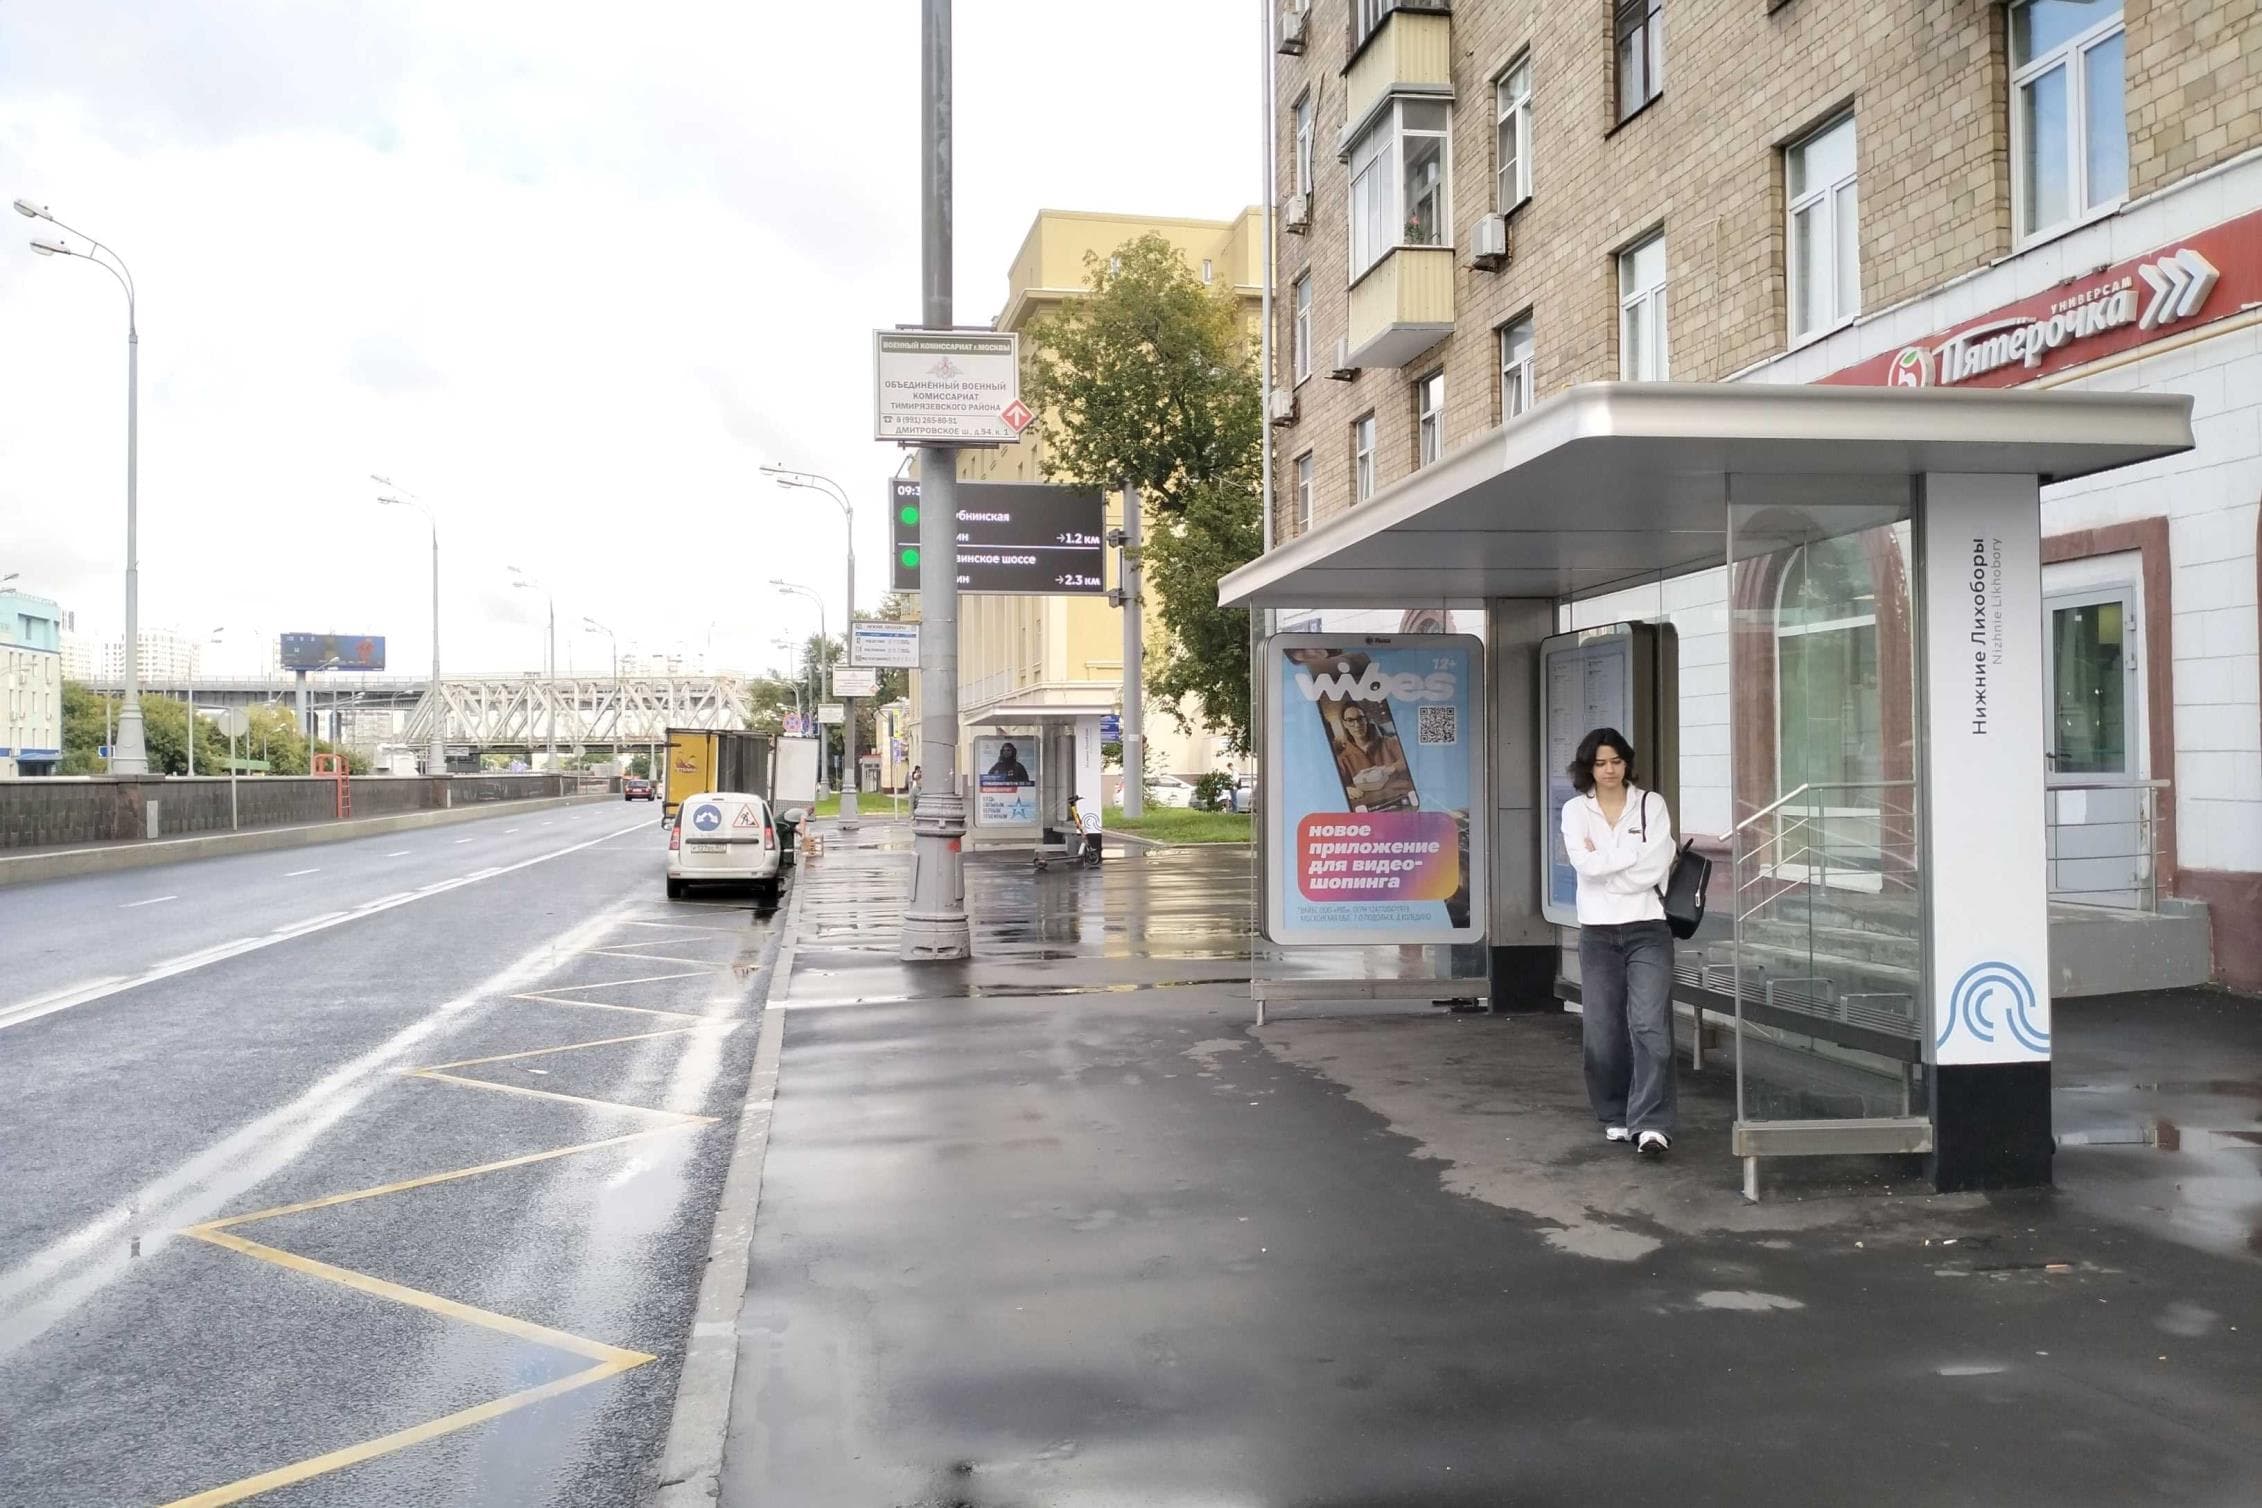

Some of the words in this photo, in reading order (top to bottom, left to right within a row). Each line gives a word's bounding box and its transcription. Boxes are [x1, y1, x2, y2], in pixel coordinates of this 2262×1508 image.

[2050, 276, 2133, 314] УНИВЕРСАМ
[883, 341, 919, 349] ВОЕННЫЙ
[920, 342, 972, 350] КОМИССАРИАТ
[962, 381, 1006, 391] ВОЕННЫЙ
[913, 393, 979, 401] КОМИССАРИАТ
[890, 402, 967, 411] ТИМИРЯЗЕВСКОГО
[968, 403, 1001, 412] РАЙОНА
[895, 427, 959, 435] ДМИТРОВСКОЕ
[897, 485, 921, 496] 09:3
[956, 510, 1010, 522] бнинская
[1065, 533, 1083, 544] 1.2
[1084, 535, 1100, 544] км
[956, 553, 1000, 564] инское
[1001, 555, 1036, 565] шоссе
[1991, 537, 2003, 607] Likhobory
[1065, 575, 1083, 585] 2.3
[1084, 577, 1100, 586] км
[1970, 538, 1988, 645] Лихоборы
[1992, 611, 2003, 665] Nizhnie
[1432, 657, 1456, 671] 12+
[1972, 651, 1987, 735] Нижние
[1309, 825, 1372, 837] новое
[1309, 841, 1440, 858] приложение
[1308, 859, 1347, 875] для
[1352, 859, 1423, 875] видео-
[1309, 876, 1401, 889] шопинга
